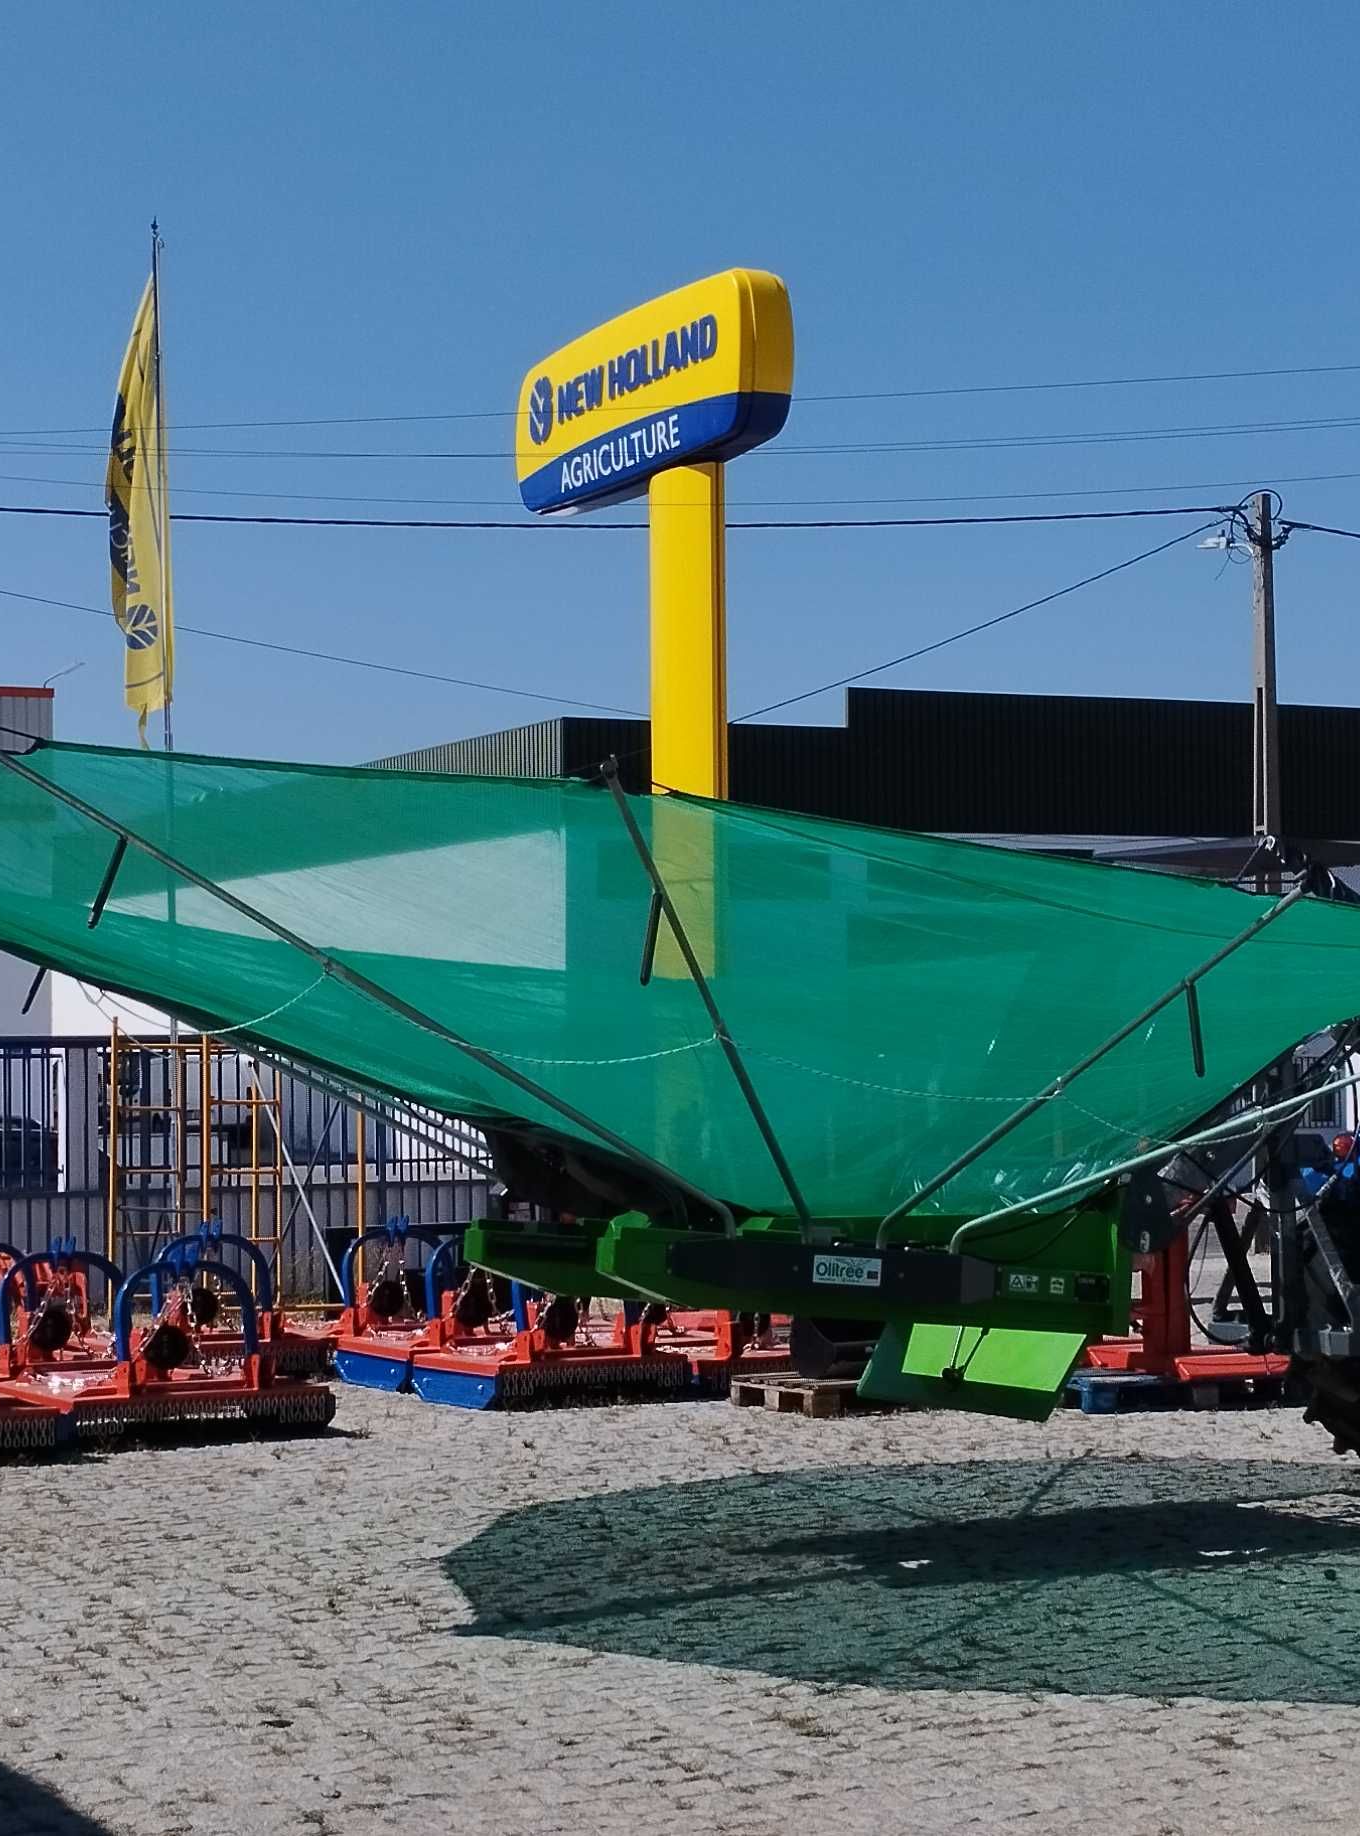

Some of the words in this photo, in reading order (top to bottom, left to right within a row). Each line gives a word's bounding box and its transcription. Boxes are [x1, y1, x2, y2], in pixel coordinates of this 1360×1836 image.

[557, 365, 604, 426] NEW
[608, 314, 717, 401] HOLLAND
[560, 414, 681, 494] AGRICULTURE
